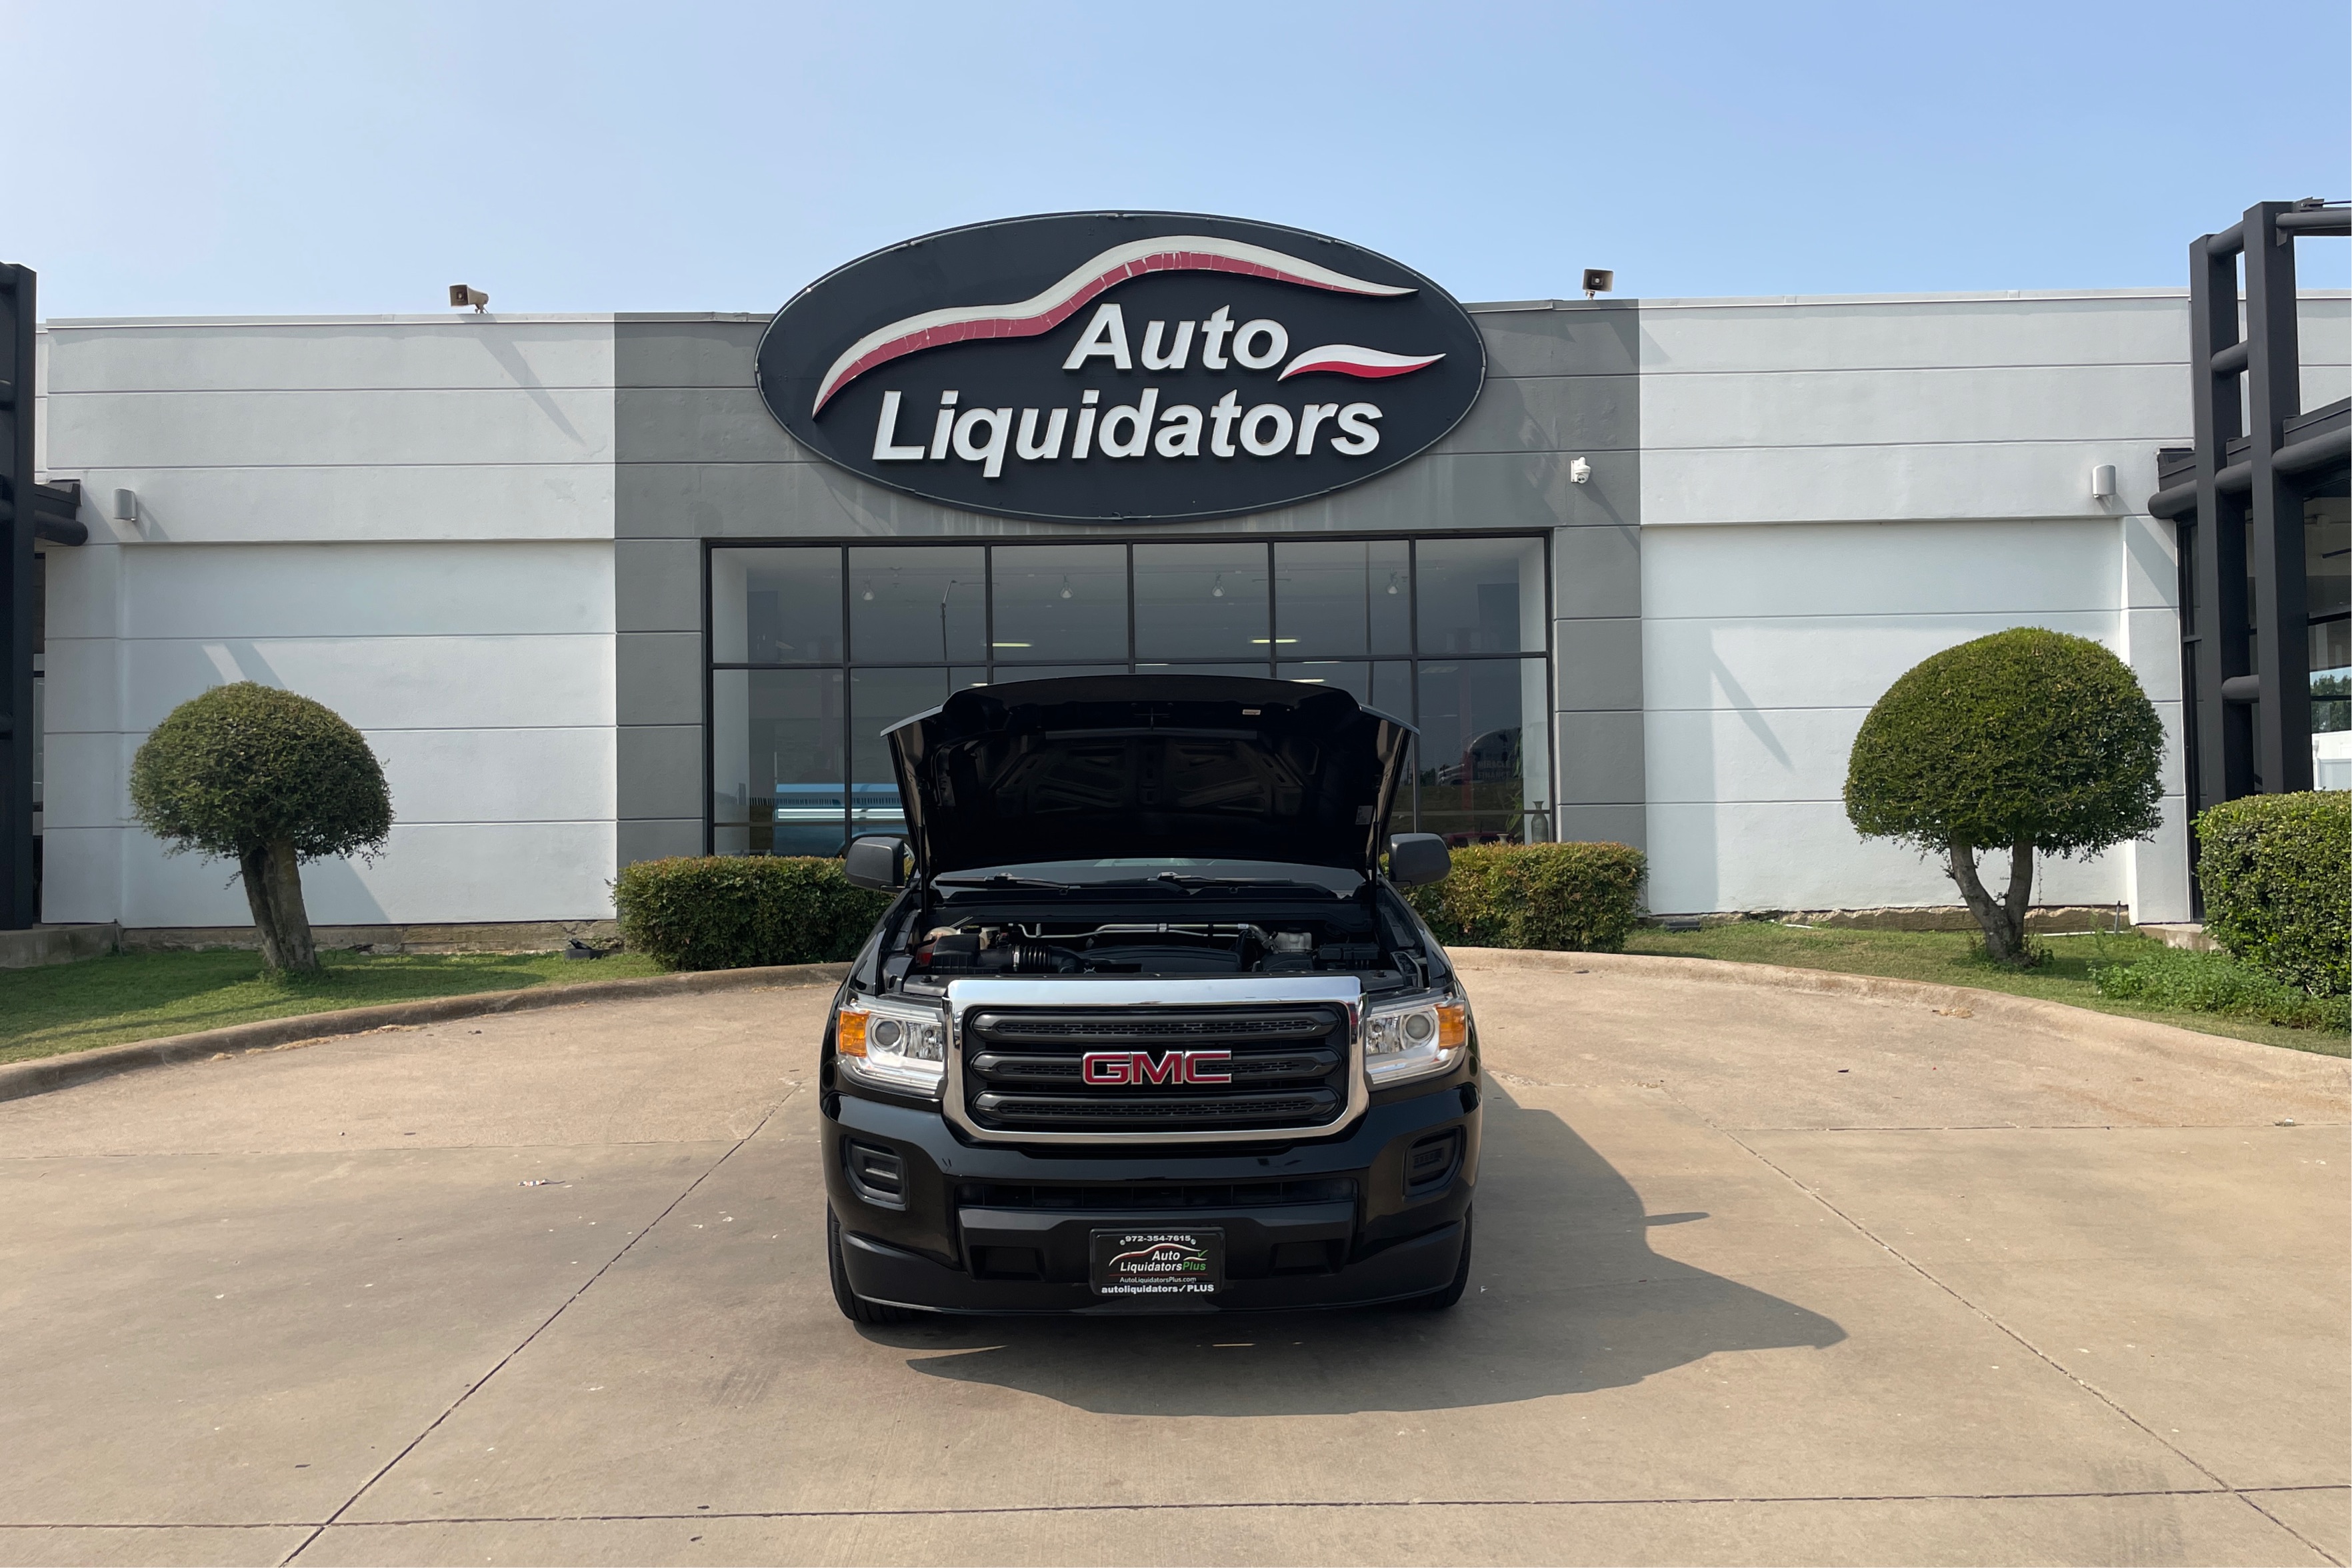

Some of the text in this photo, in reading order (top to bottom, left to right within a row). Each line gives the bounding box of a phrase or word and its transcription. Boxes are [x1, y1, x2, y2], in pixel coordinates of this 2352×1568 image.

[1063, 303, 1289, 372] Auto
[872, 387, 1385, 479] Liquidators
[1082, 1050, 1232, 1085] GMC
[1151, 1250, 1181, 1261] Auto
[1119, 1276, 1197, 1284] AutoLiquidatorsPlus.com
